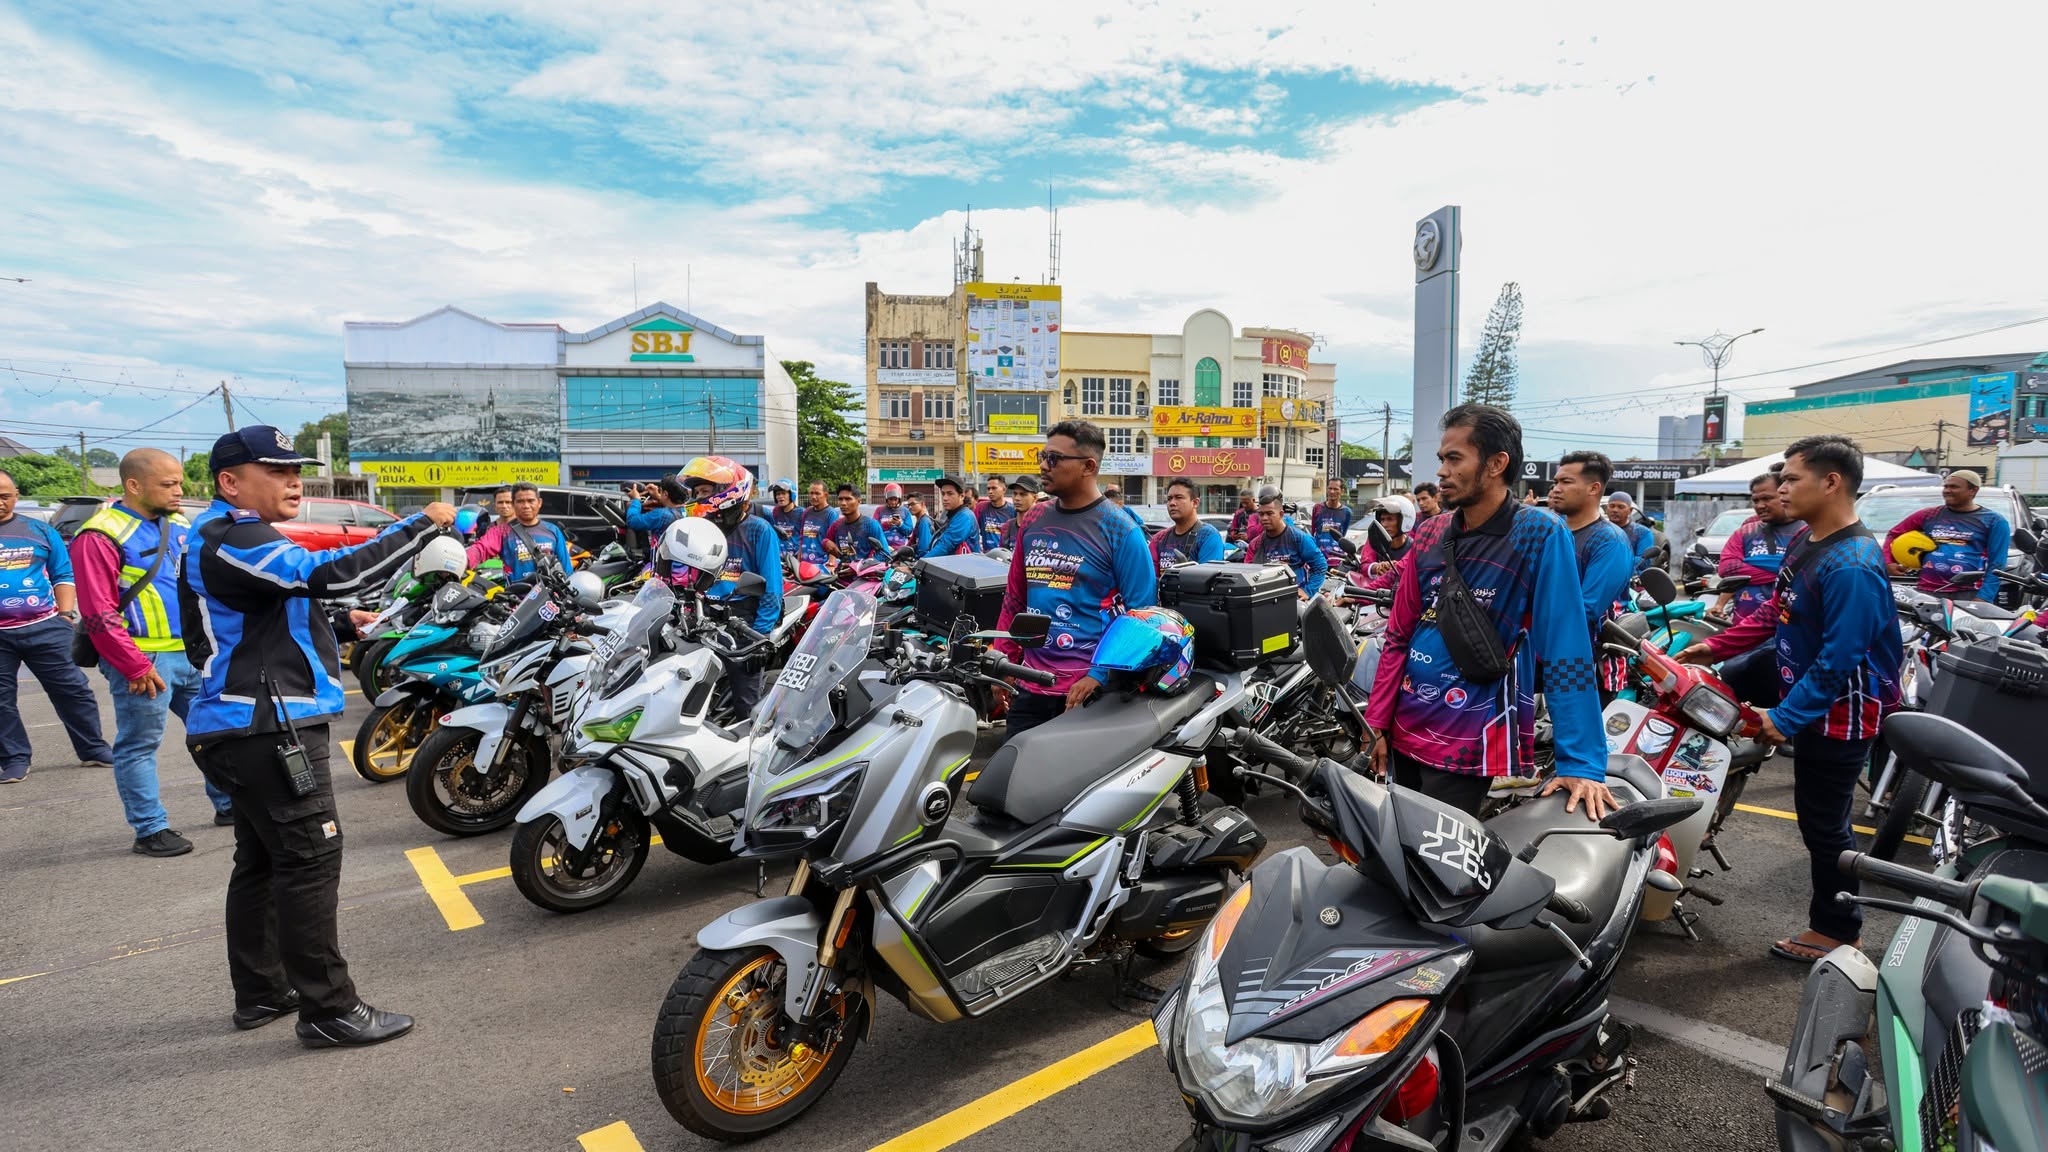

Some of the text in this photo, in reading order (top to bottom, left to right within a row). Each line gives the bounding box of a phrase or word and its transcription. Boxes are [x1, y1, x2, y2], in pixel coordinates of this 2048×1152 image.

[631, 332, 692, 354] SBJ
[380, 465, 405, 473] KINI
[1643, 471, 1661, 479] SDN
[1662, 471, 1681, 480] BHD
[790, 652, 818, 672] RBD
[777, 669, 811, 691] 2984
[1664, 777, 1689, 786] MOLY
